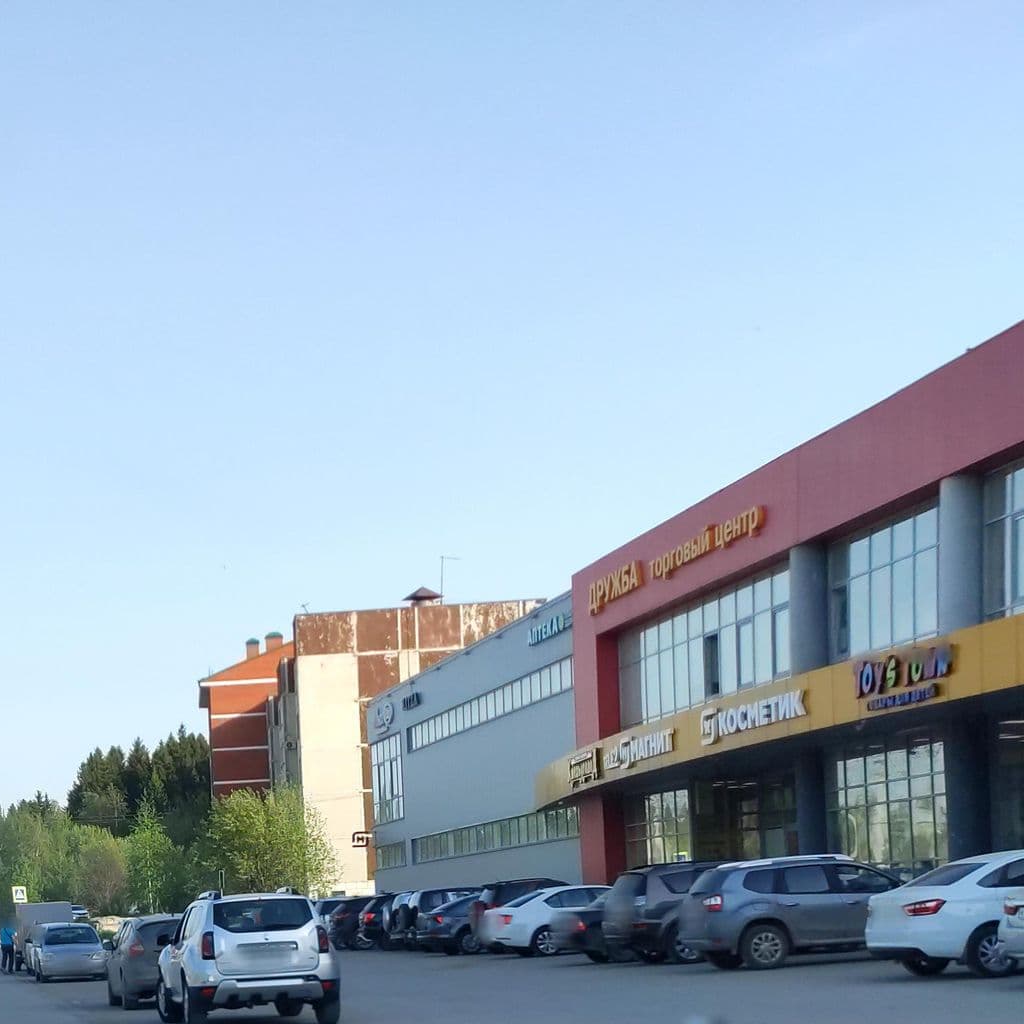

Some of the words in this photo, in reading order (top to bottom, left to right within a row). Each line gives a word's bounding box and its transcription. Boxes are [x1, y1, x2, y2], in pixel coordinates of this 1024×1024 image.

[588, 561, 641, 616] ДРУЖБА
[649, 523, 716, 579] торговый
[714, 504, 765, 548] центр
[528, 616, 559, 646] АПТЕКА
[853, 656, 897, 698] TOYS
[719, 688, 807, 736] КОСМЕТИК
[631, 728, 675, 761] МАГНИТ
